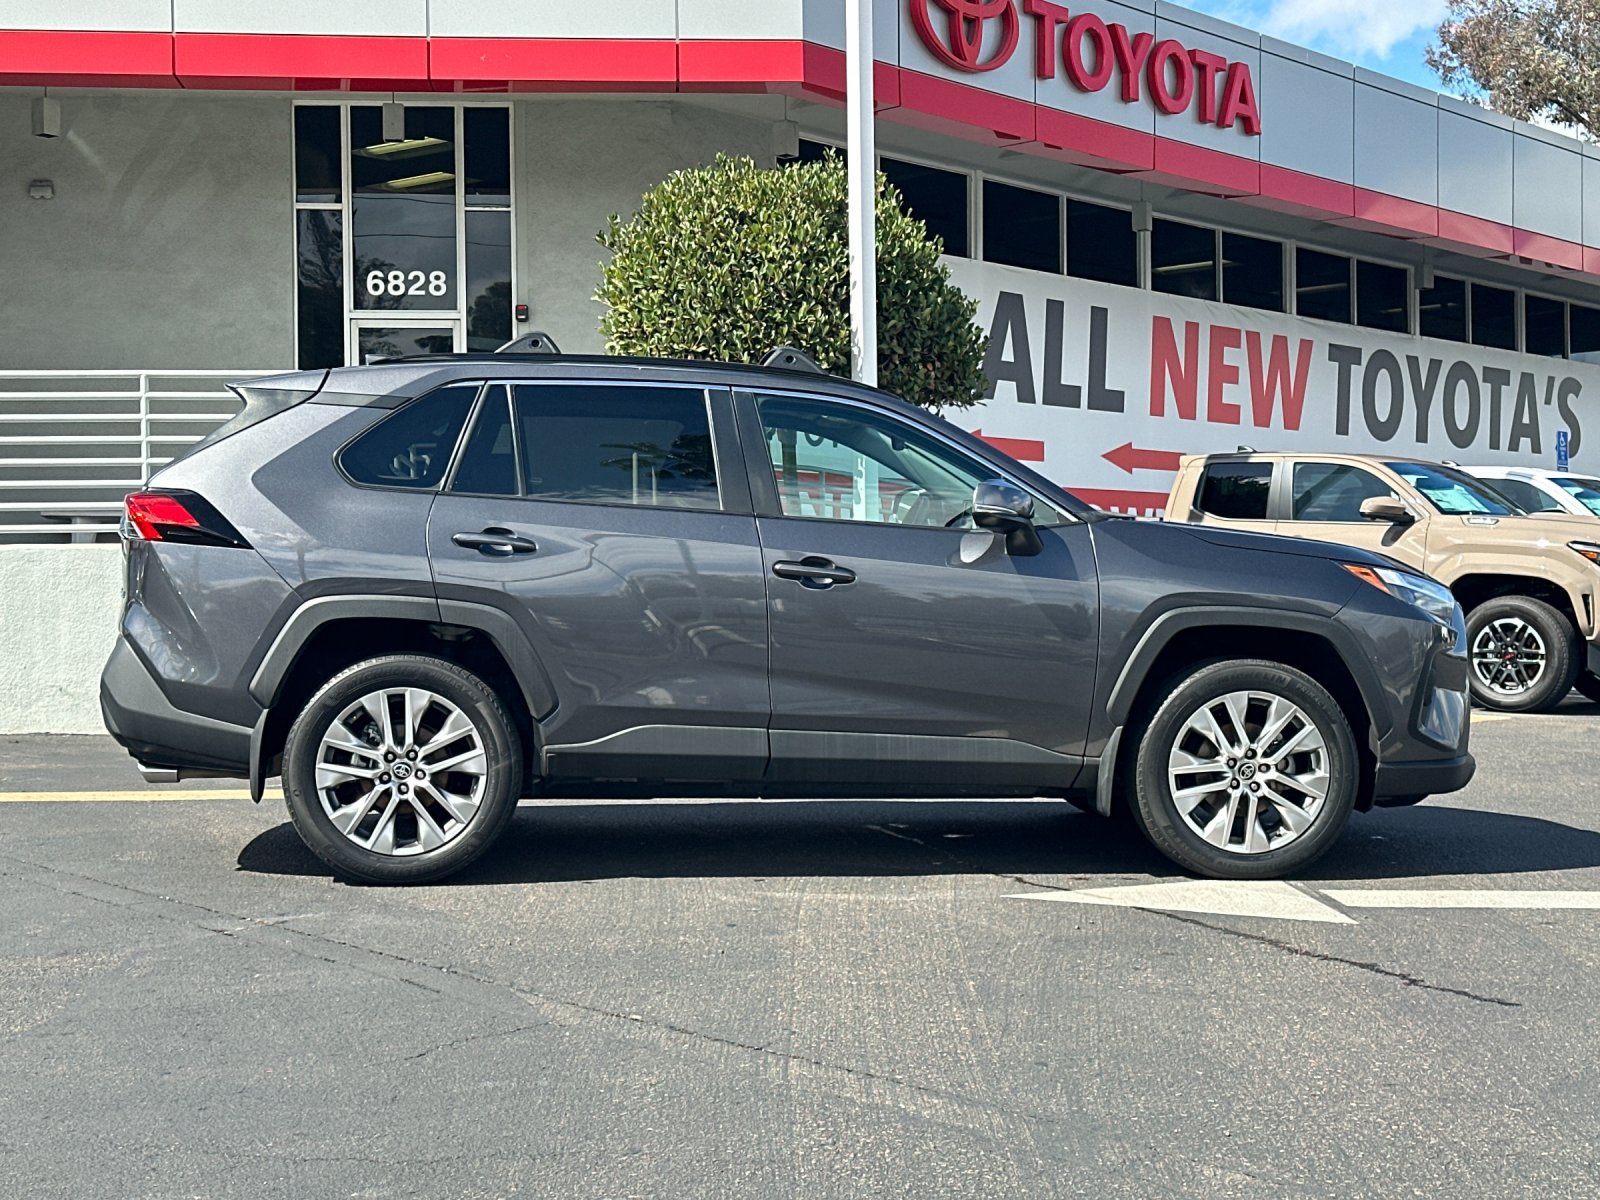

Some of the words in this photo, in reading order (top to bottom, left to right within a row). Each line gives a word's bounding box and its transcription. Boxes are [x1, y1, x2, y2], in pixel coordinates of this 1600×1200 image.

[1024, 0, 1261, 136] TOYOTA
[366, 270, 447, 297] 6828
[981, 290, 1125, 413] ALL
[1149, 315, 1314, 431] NEW
[1327, 342, 1583, 459] TOYOTA'S
